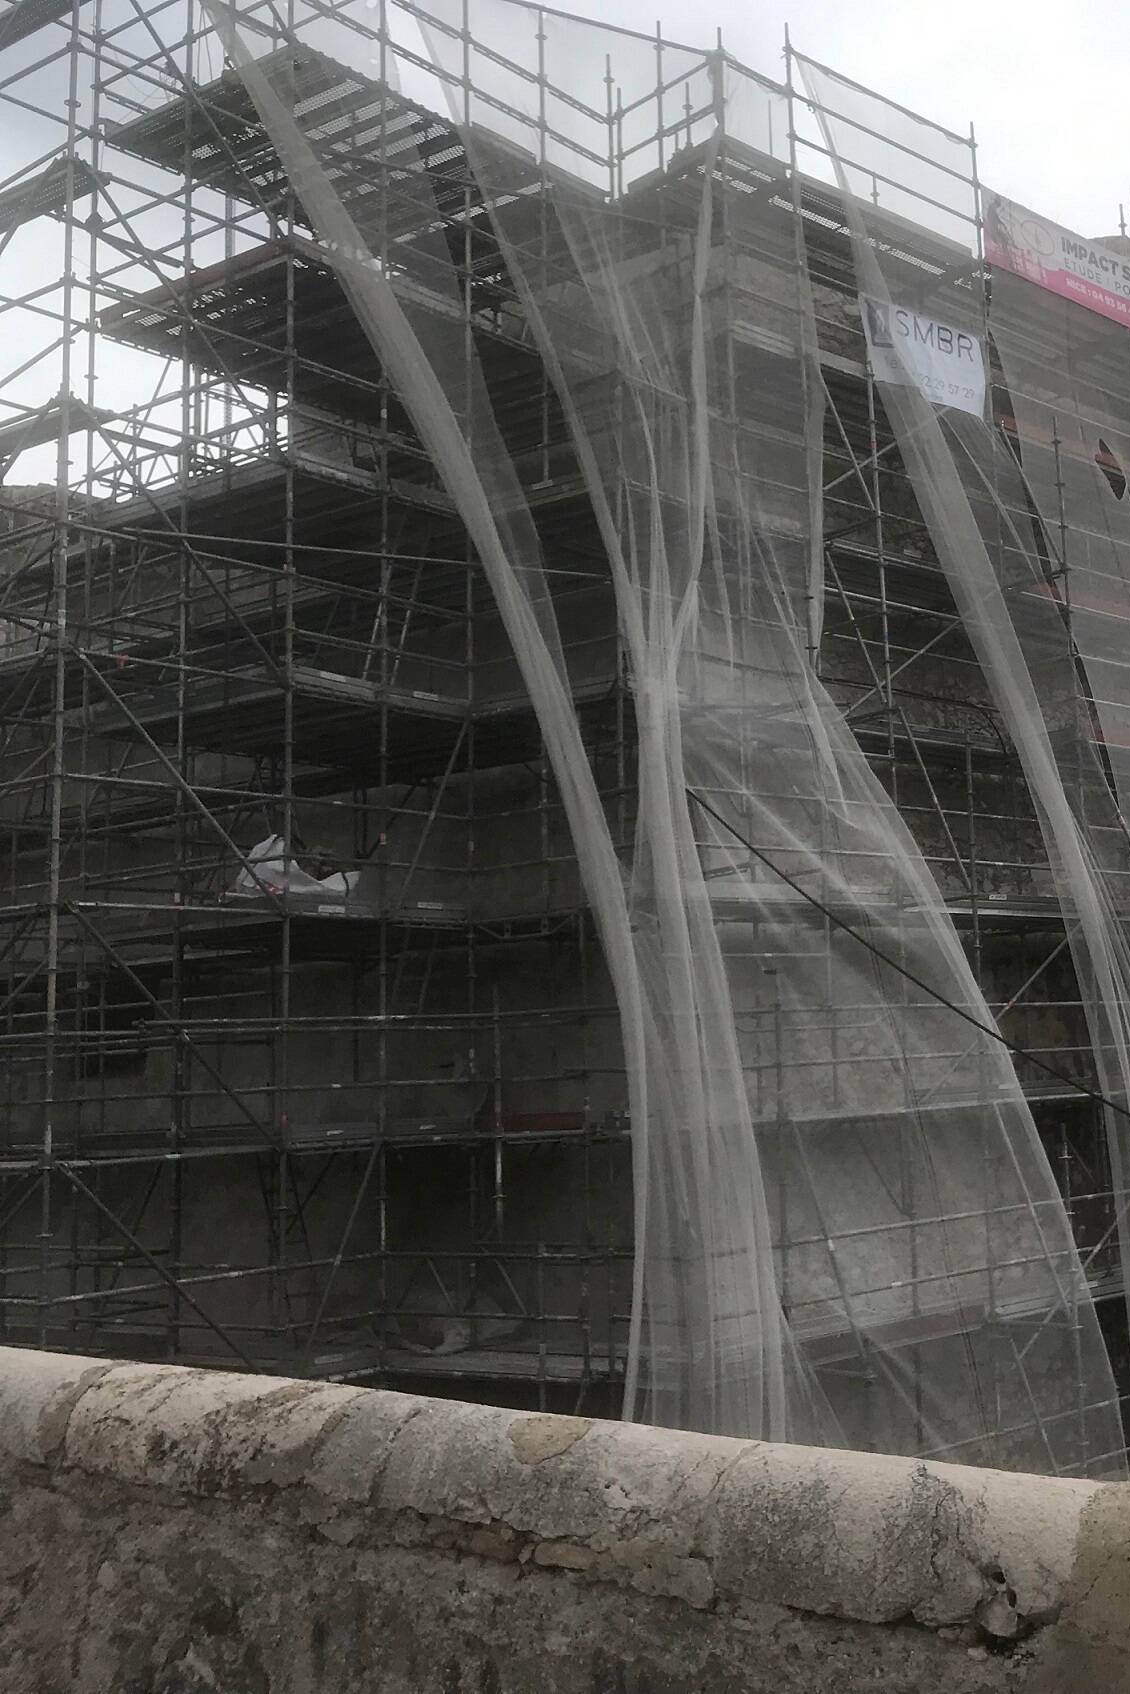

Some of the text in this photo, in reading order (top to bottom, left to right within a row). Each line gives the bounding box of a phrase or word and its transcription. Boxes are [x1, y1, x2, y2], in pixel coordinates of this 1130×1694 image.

[1061, 236, 1119, 276] IMPACT
[1064, 256, 1103, 284] ETUDE
[1065, 278, 1087, 294] NICE
[896, 310, 974, 362] SMBR
